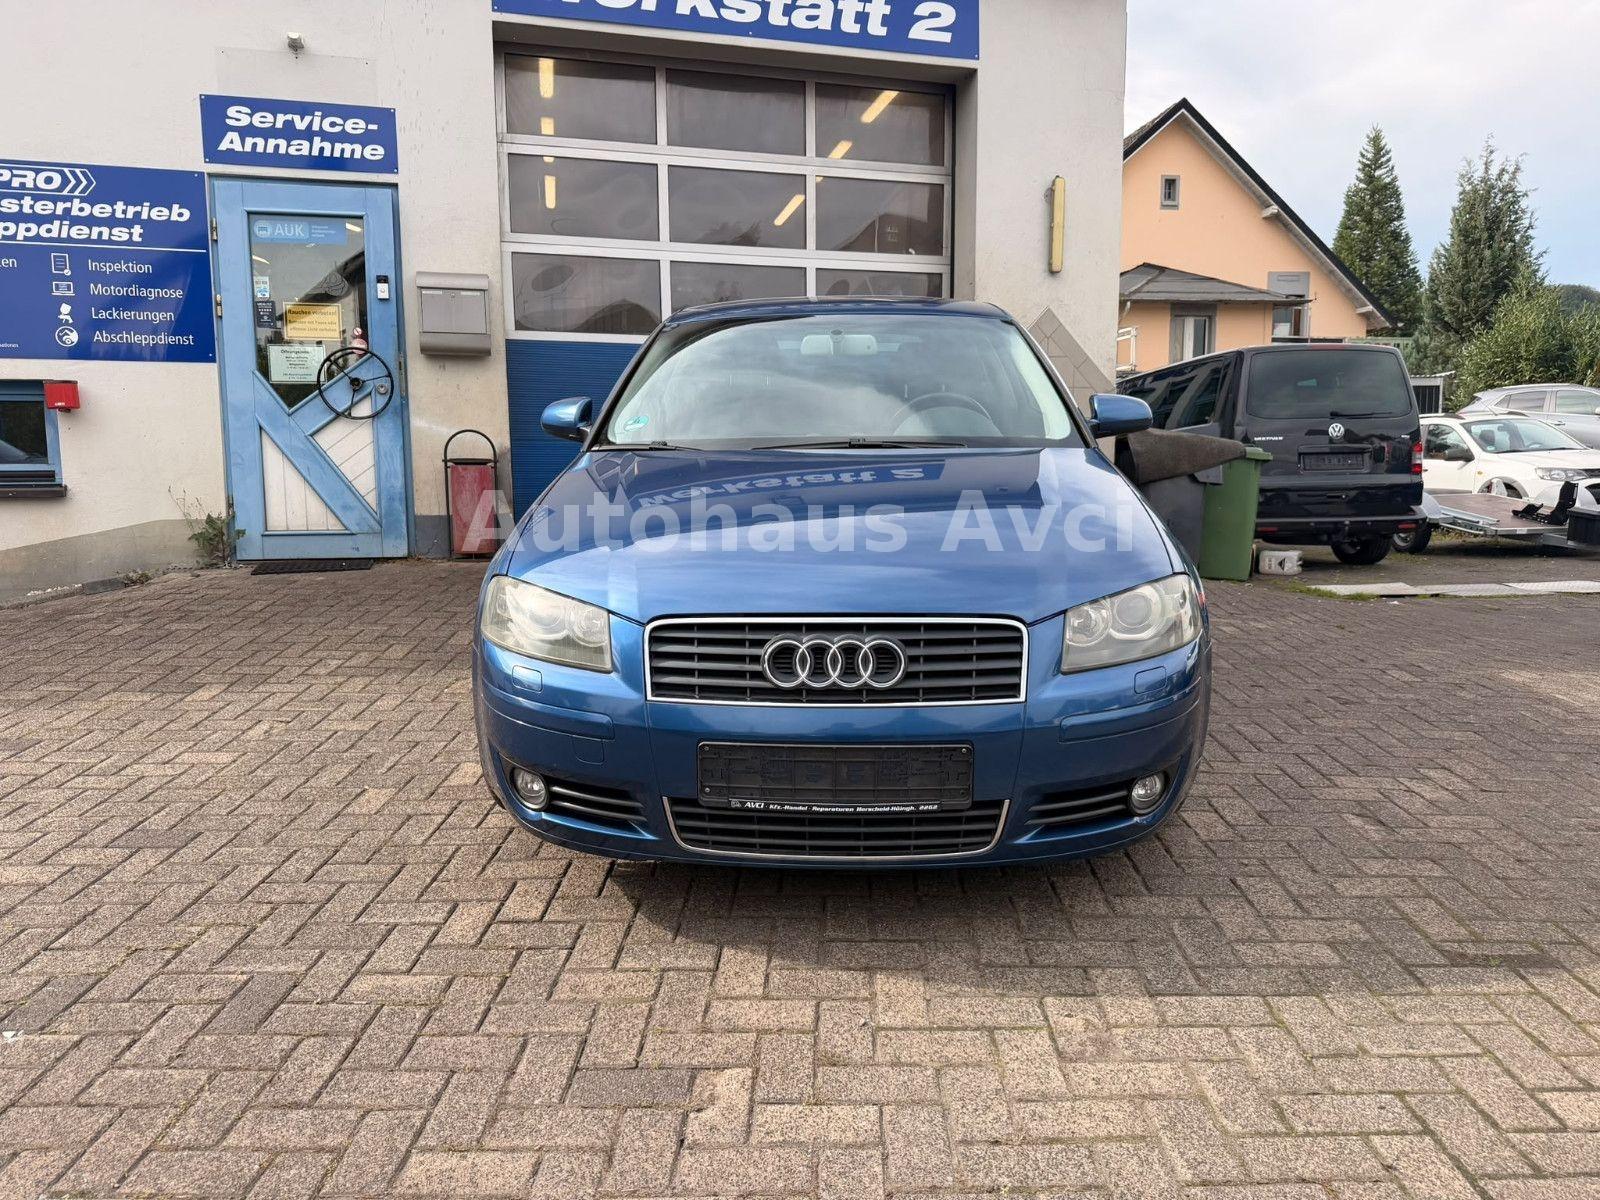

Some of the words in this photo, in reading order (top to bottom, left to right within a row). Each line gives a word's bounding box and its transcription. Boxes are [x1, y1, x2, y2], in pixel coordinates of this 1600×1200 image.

[908, 1, 956, 43] 2
[225, 105, 379, 135] Service-
[217, 131, 386, 161] Annahme
[88, 259, 153, 275] Inspektion
[90, 283, 184, 300] Motordiagnose
[91, 307, 175, 324] Lackierungen
[93, 330, 194, 347] Abschleppdienst
